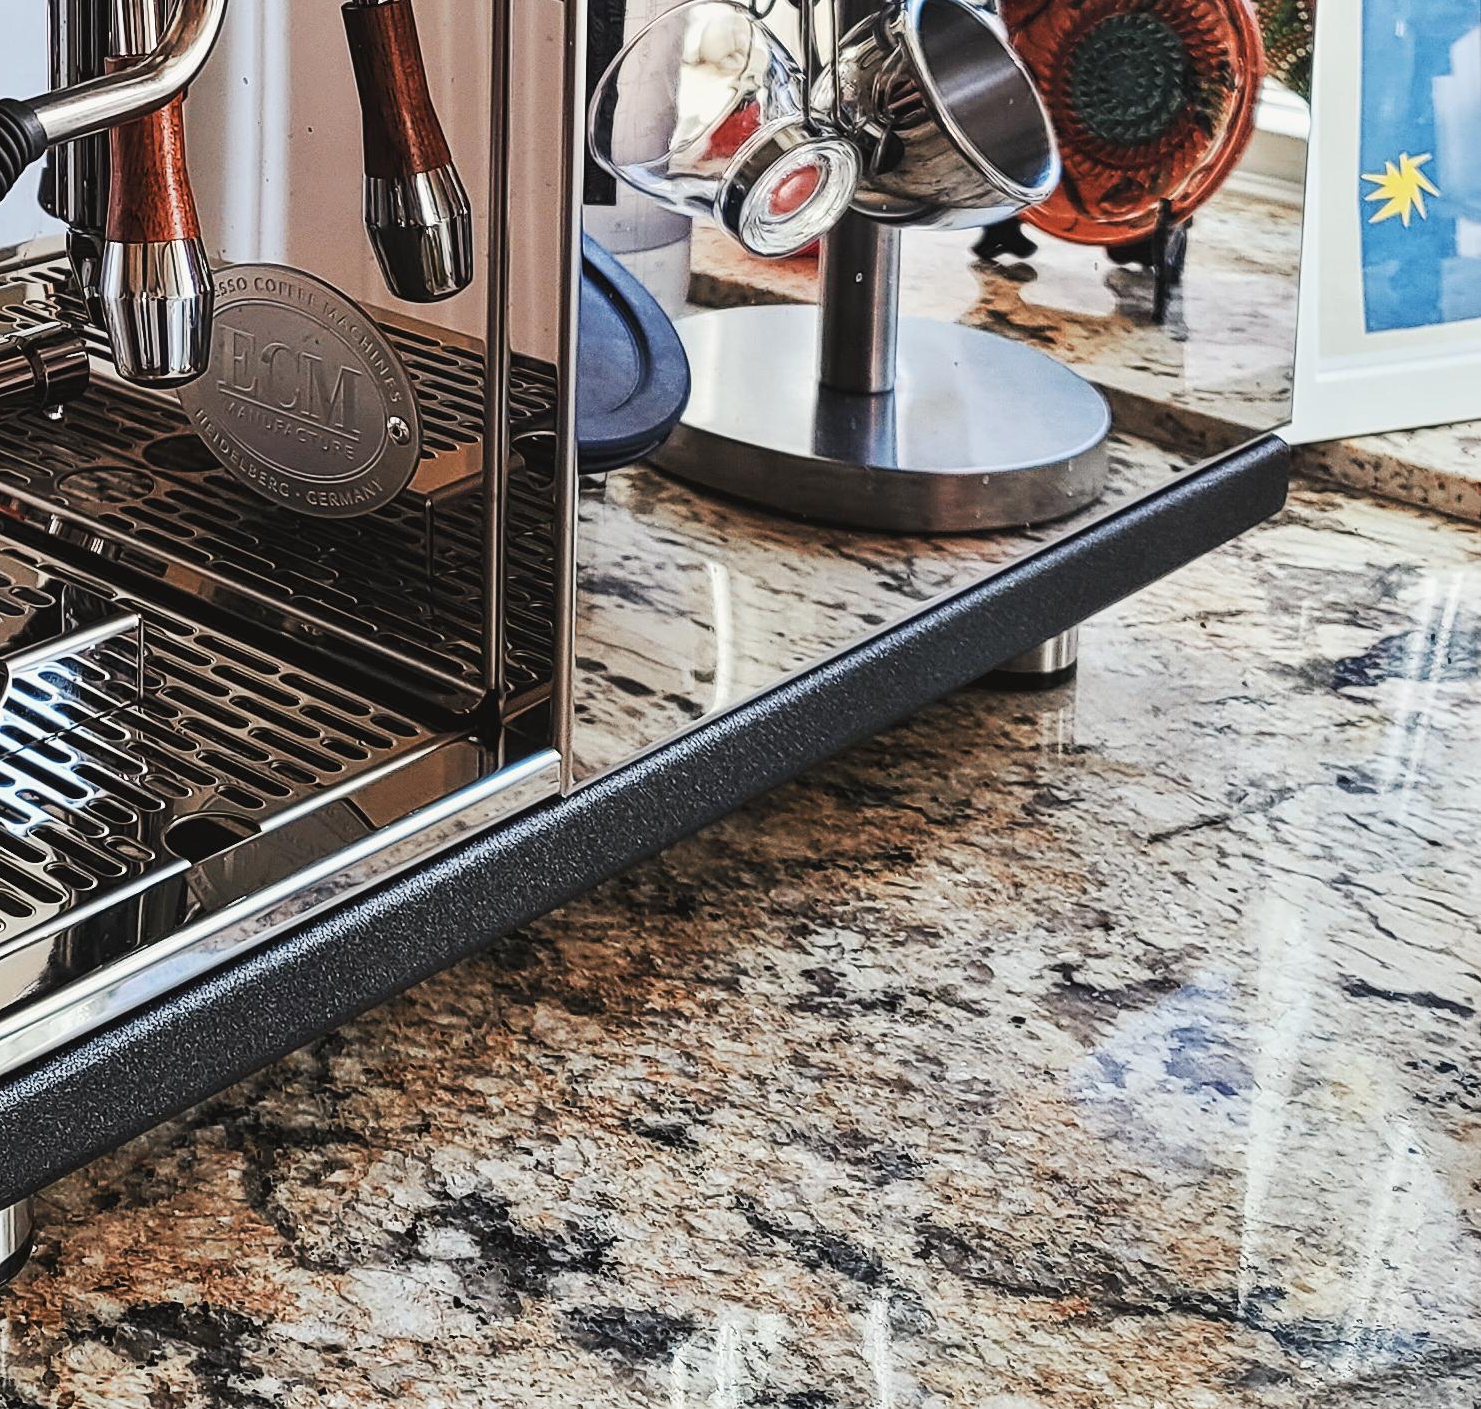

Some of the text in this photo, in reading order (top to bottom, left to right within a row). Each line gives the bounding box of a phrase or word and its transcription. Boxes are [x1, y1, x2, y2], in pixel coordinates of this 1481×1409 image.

[217, 324, 363, 435] ECM
[254, 276, 317, 308] COFFEE
[321, 302, 401, 404] MACHINES
[193, 407, 385, 507] HEIDELBERG GERMANY
[225, 400, 355, 461] MANUFACTURE
